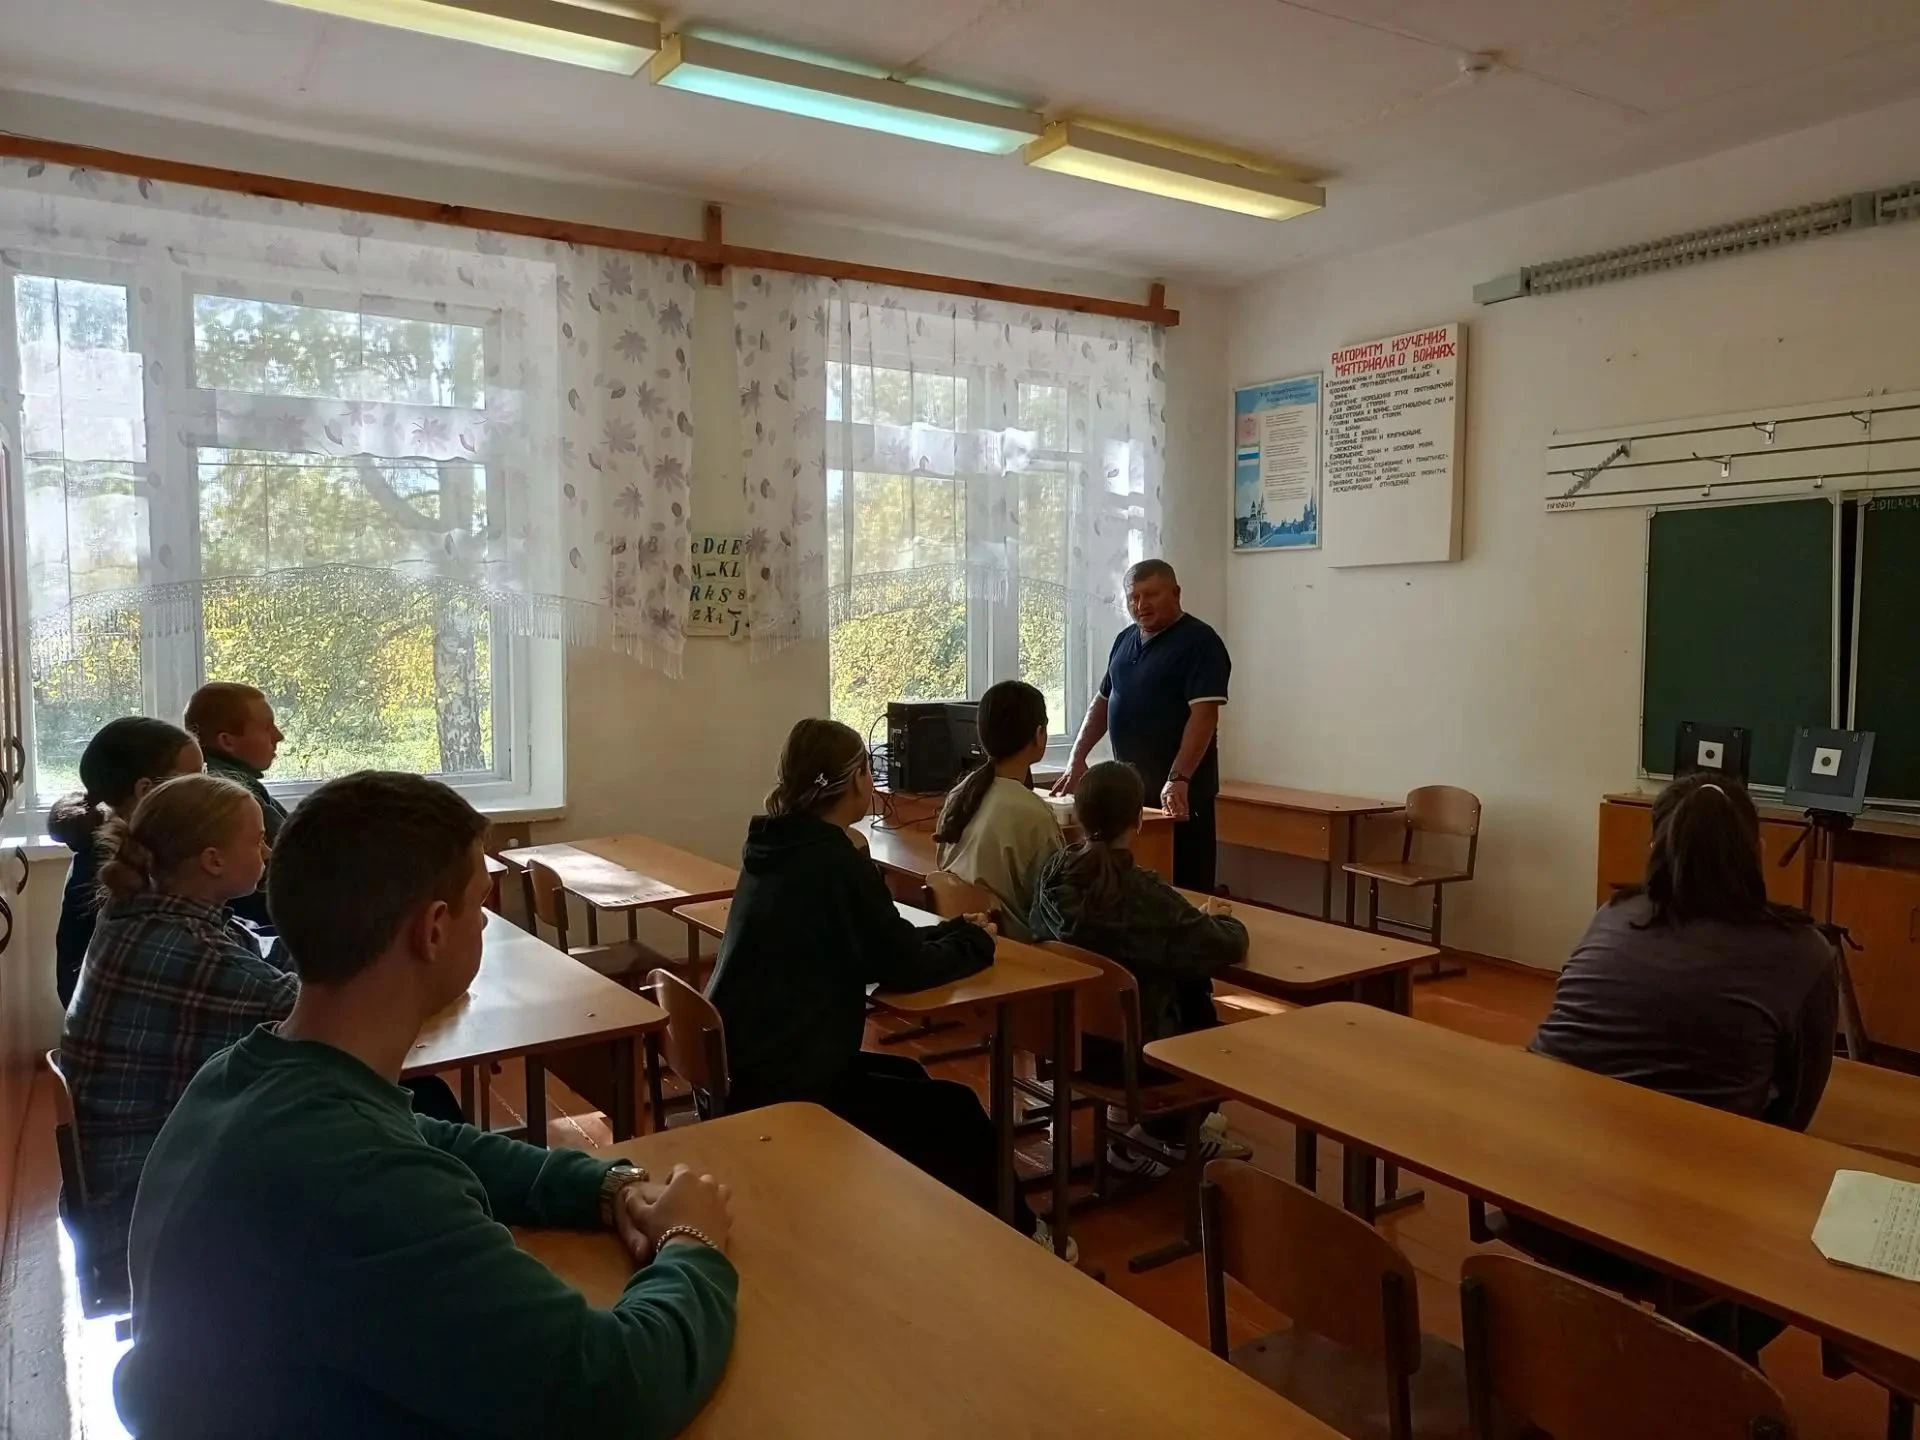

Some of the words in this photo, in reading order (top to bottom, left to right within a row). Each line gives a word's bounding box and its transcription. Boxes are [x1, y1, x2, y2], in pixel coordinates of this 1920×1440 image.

[1332, 343, 1383, 365] АЛГОРИТМ
[1392, 328, 1447, 353] ИЗУЧЕНИЯ
[1398, 352, 1406, 366] О
[1412, 342, 1456, 363] ВОЙНАХ
